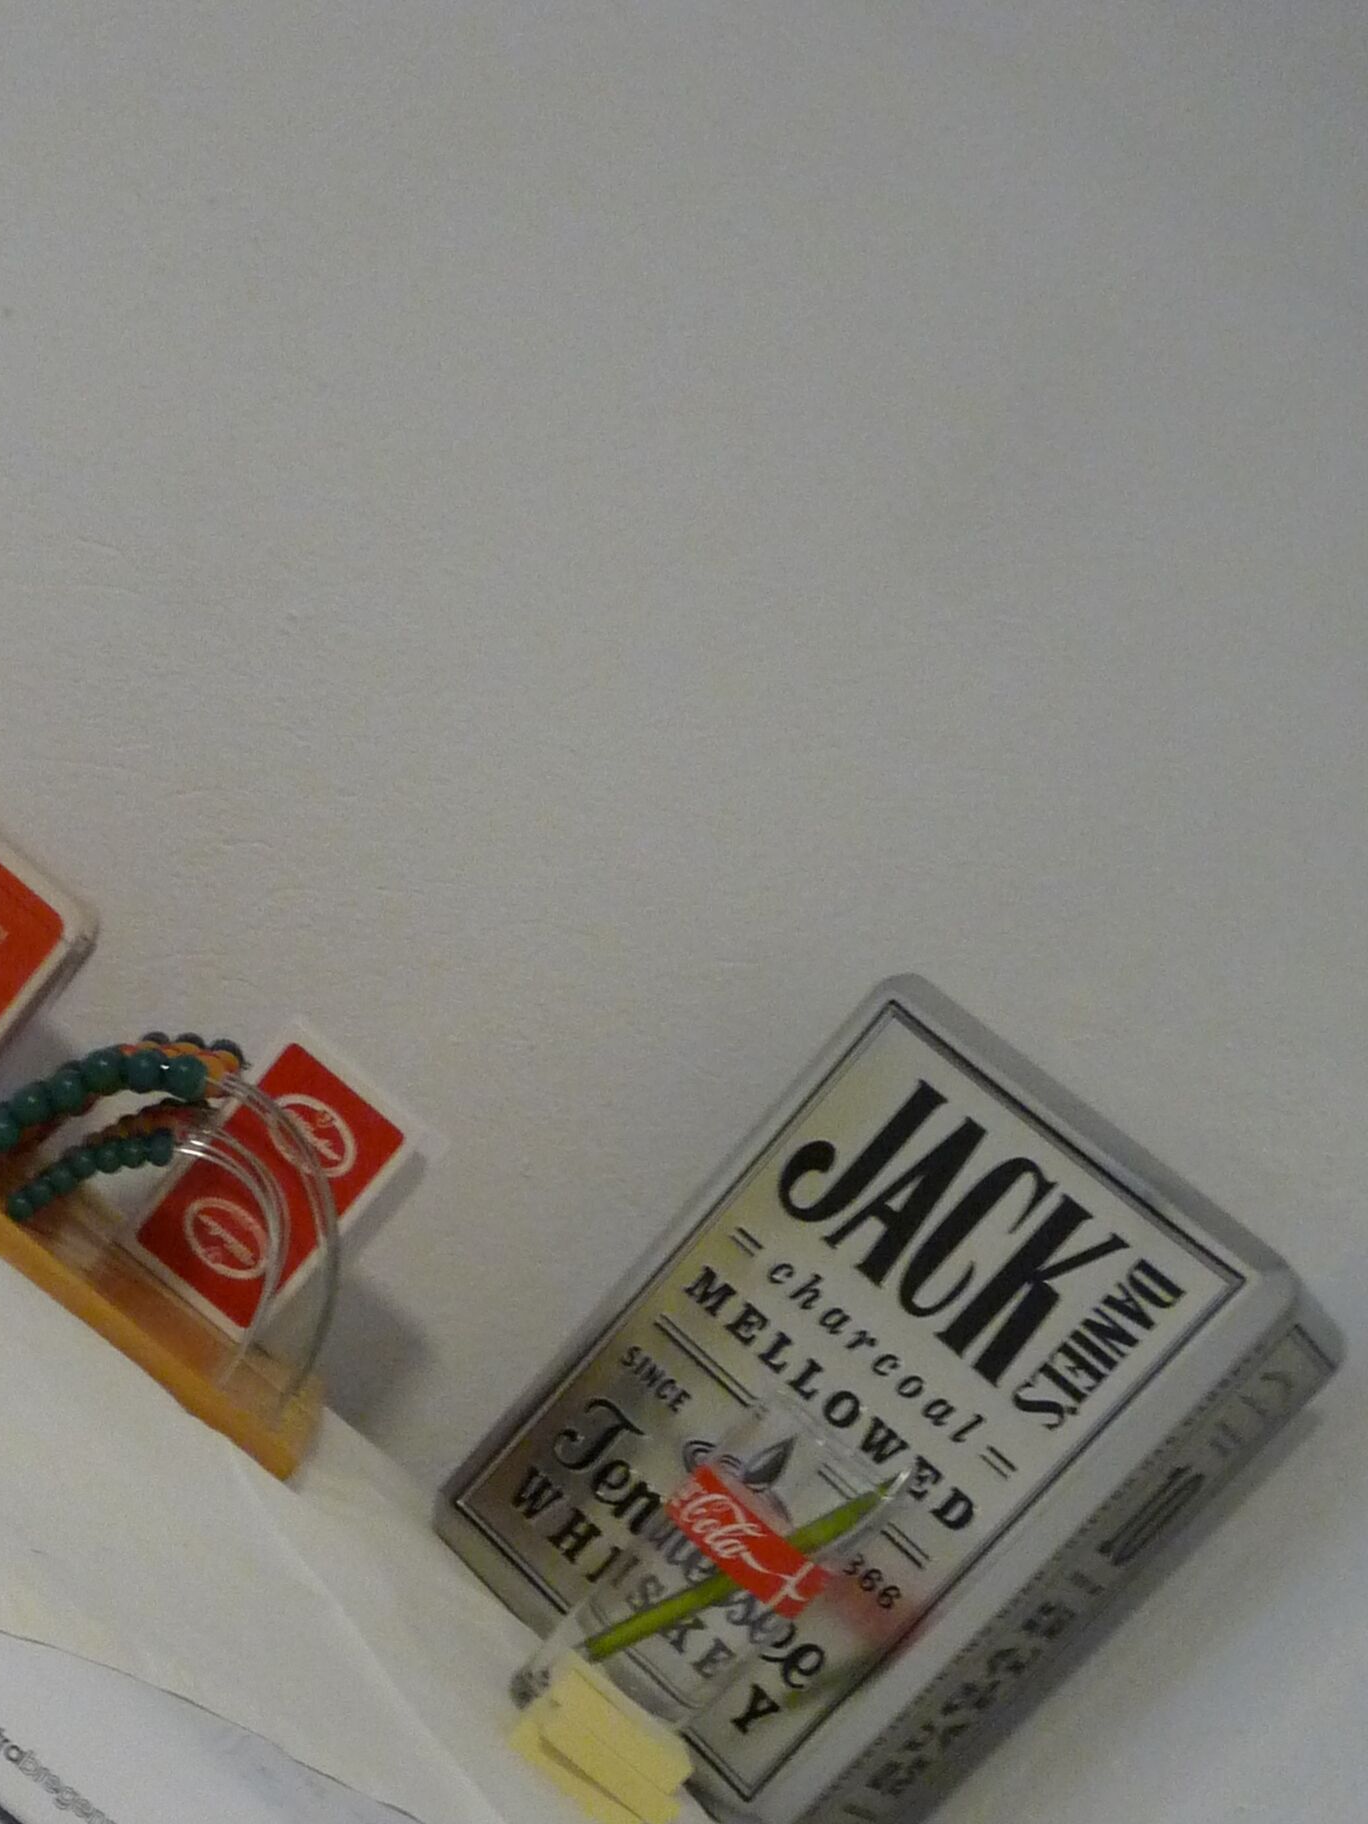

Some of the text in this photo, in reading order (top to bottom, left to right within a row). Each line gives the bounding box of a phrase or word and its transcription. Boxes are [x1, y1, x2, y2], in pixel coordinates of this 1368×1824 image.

[778, 1079, 1130, 1387] JACK
[622, 1346, 692, 1413] SINCE
[684, 1266, 974, 1530] MELLOWED
[767, 1263, 984, 1444] charcoal
